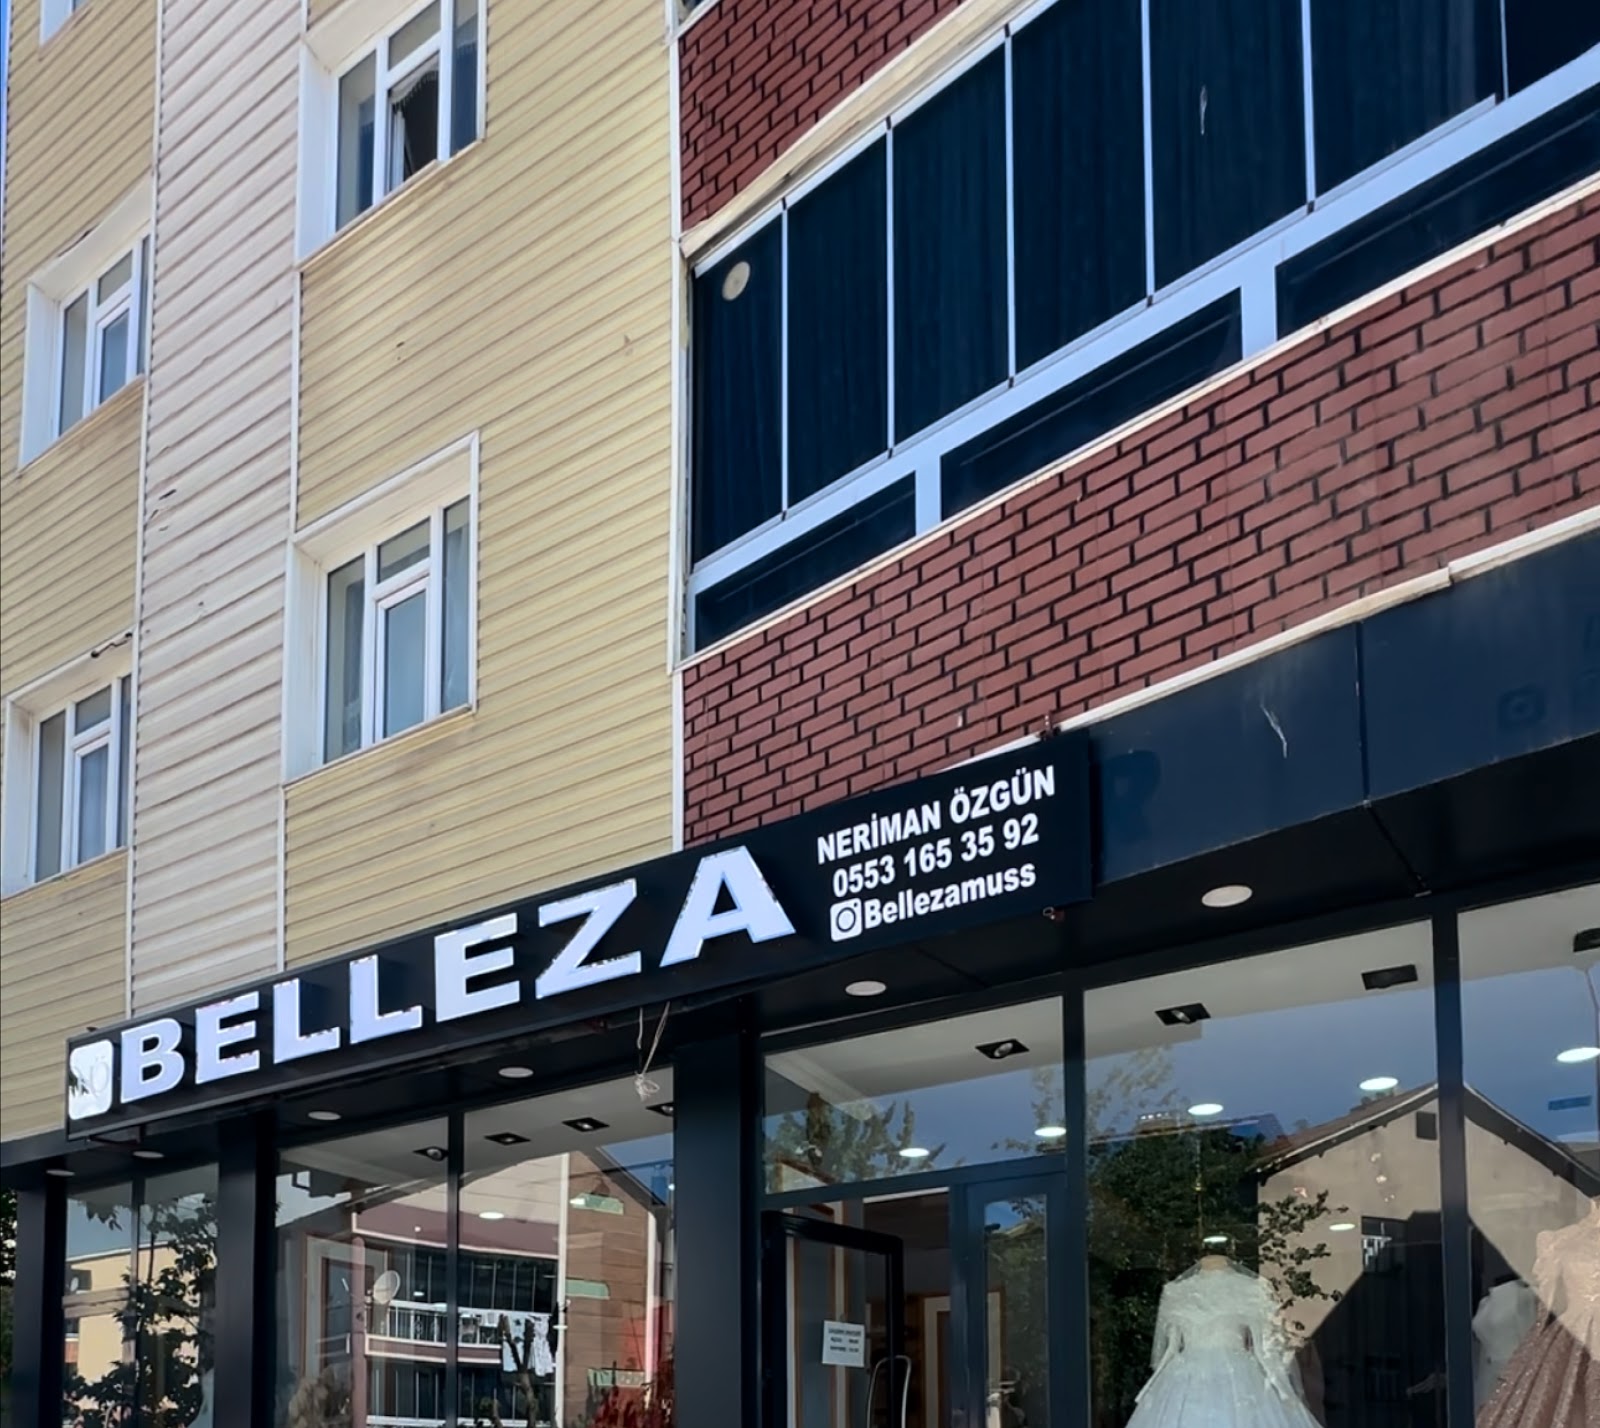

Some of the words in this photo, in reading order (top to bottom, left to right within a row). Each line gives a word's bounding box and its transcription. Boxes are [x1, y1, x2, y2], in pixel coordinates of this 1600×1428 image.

[817, 801, 941, 864] NERİMAN
[950, 765, 1055, 823] ÖZGÜN
[833, 855, 896, 897] 0553
[904, 837, 952, 876] 165
[961, 825, 995, 861] 35
[1003, 813, 1039, 849] 92
[864, 863, 1036, 929] Bellezamuss
[120, 845, 796, 1103] BELLEZA
